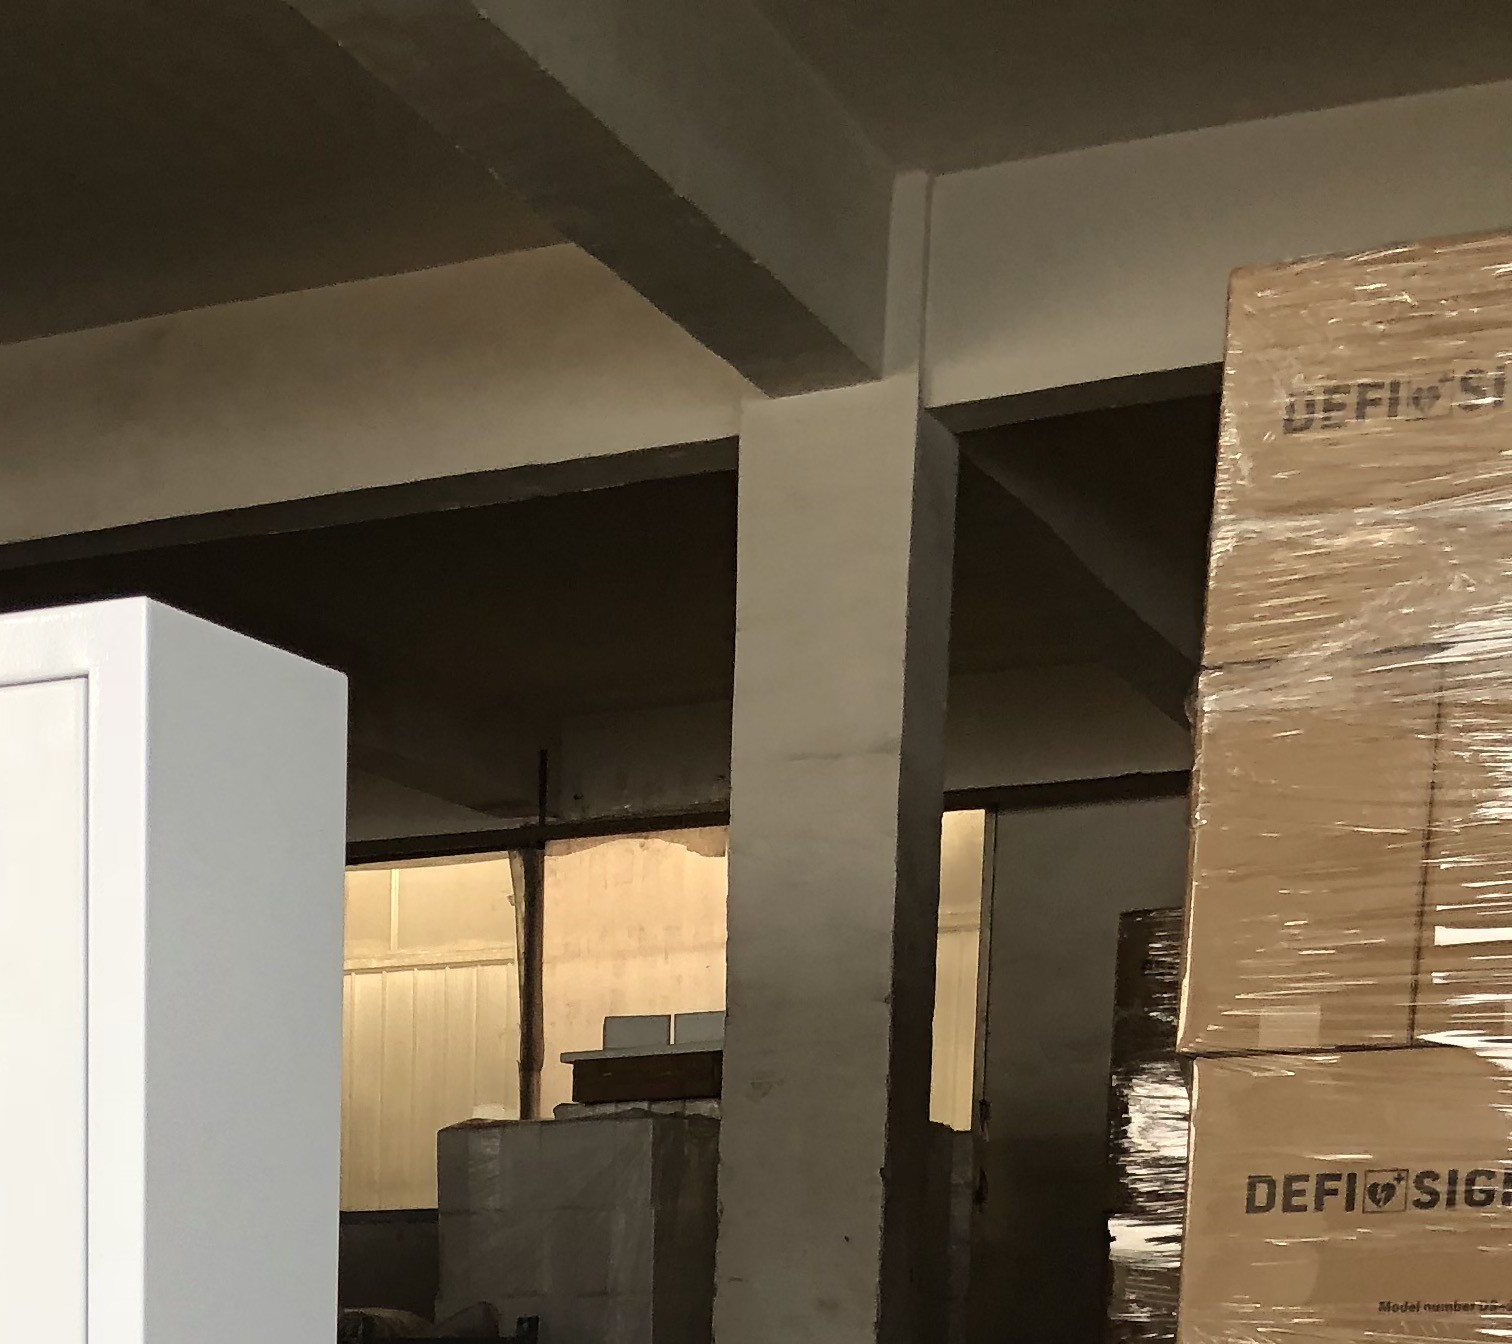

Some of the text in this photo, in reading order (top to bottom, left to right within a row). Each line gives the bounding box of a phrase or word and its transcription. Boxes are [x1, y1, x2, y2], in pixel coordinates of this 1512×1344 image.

[1283, 380, 1400, 434] DEFI
[1245, 1172, 1358, 1214] DEFI
[1378, 1301, 1420, 1313] Model
[1423, 1301, 1475, 1312] number
